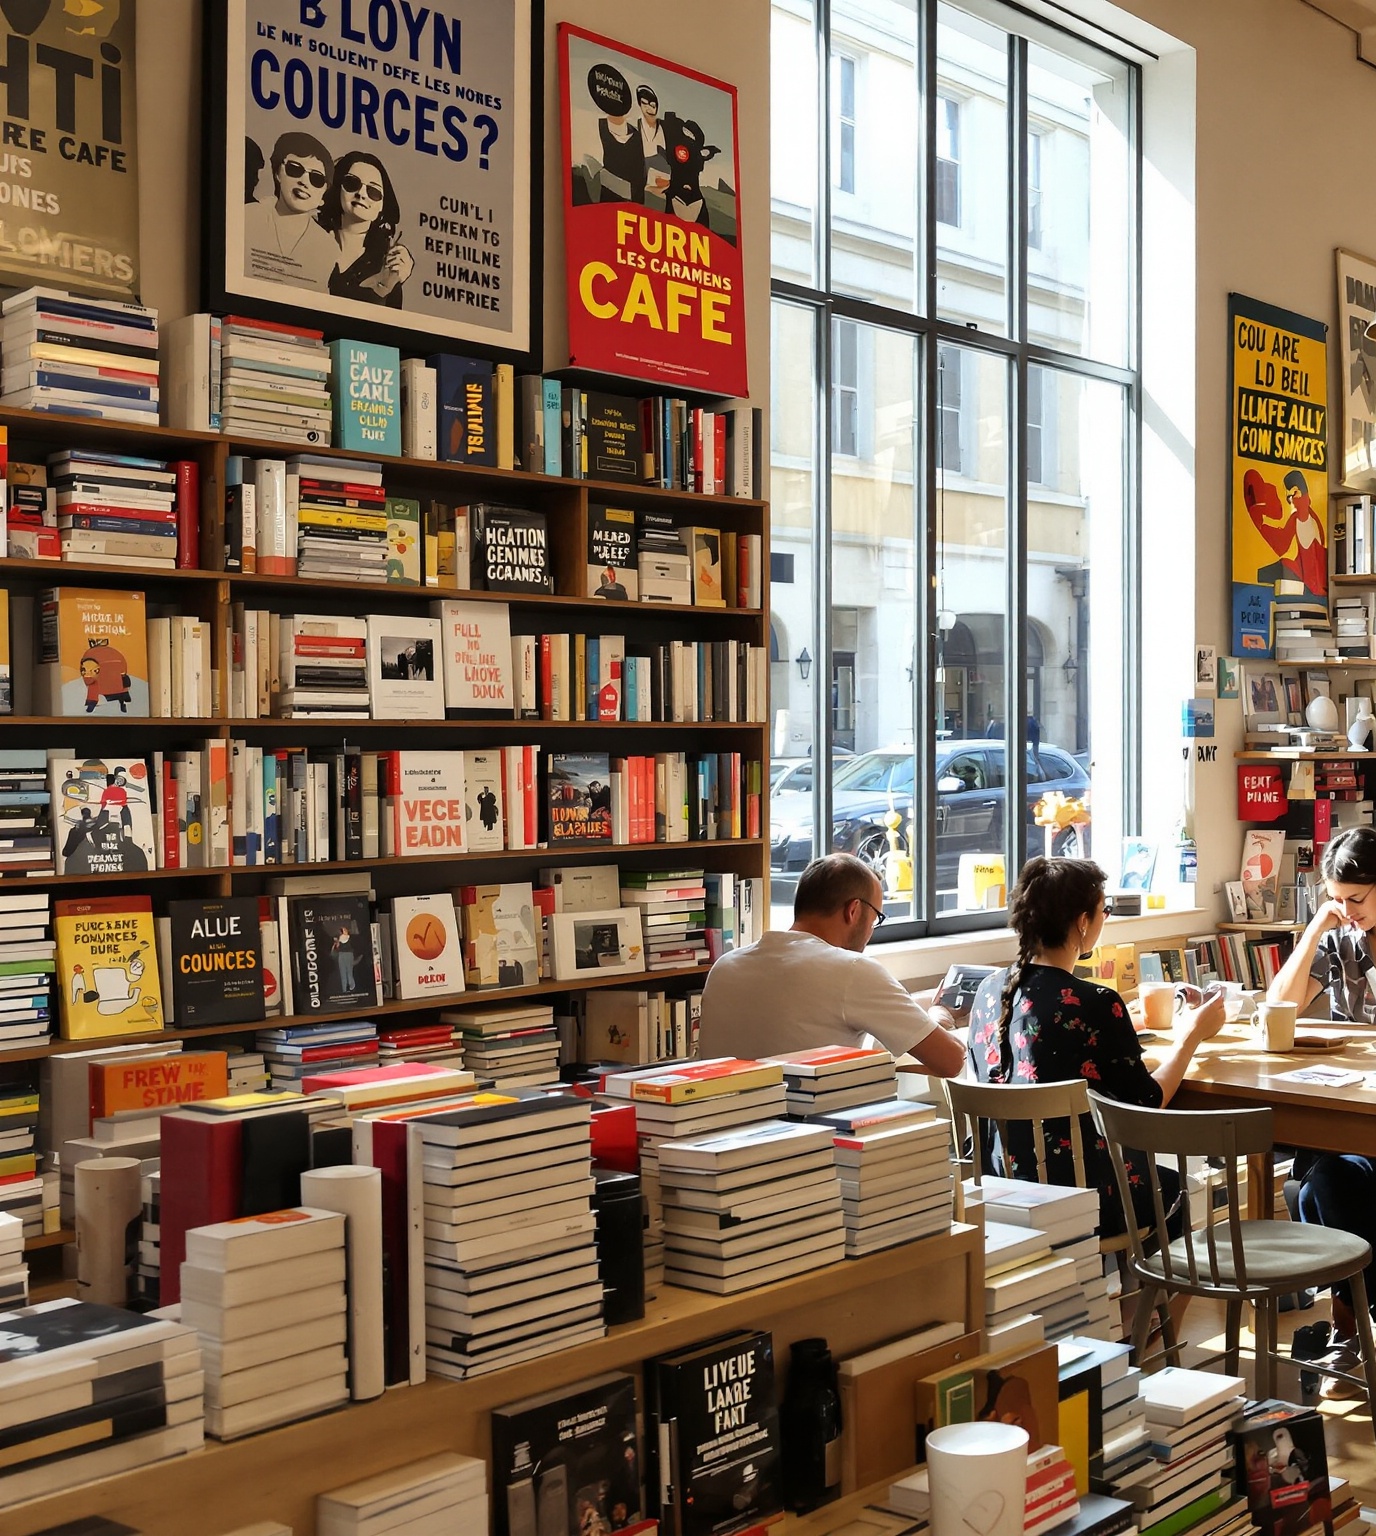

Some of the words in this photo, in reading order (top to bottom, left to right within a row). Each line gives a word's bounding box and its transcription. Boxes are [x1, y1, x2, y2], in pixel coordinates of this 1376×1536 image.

[425, 75, 451, 94] LES
[251, 48, 499, 171] COURCES?
[58, 137, 127, 173] CAFE
[617, 210, 710, 268] FURN
[617, 248, 646, 270] LES
[437, 261, 501, 290] HUMANS
[579, 261, 732, 345] CAFE
[1238, 322, 1266, 353] COU
[1271, 332, 1300, 364] ARE
[1288, 404, 1325, 435] ALLY
[403, 799, 462, 822] VECE
[405, 825, 463, 848] EADN
[191, 916, 242, 939] ALUE
[180, 950, 256, 974] COUNCES
[123, 1065, 182, 1089] FREW
